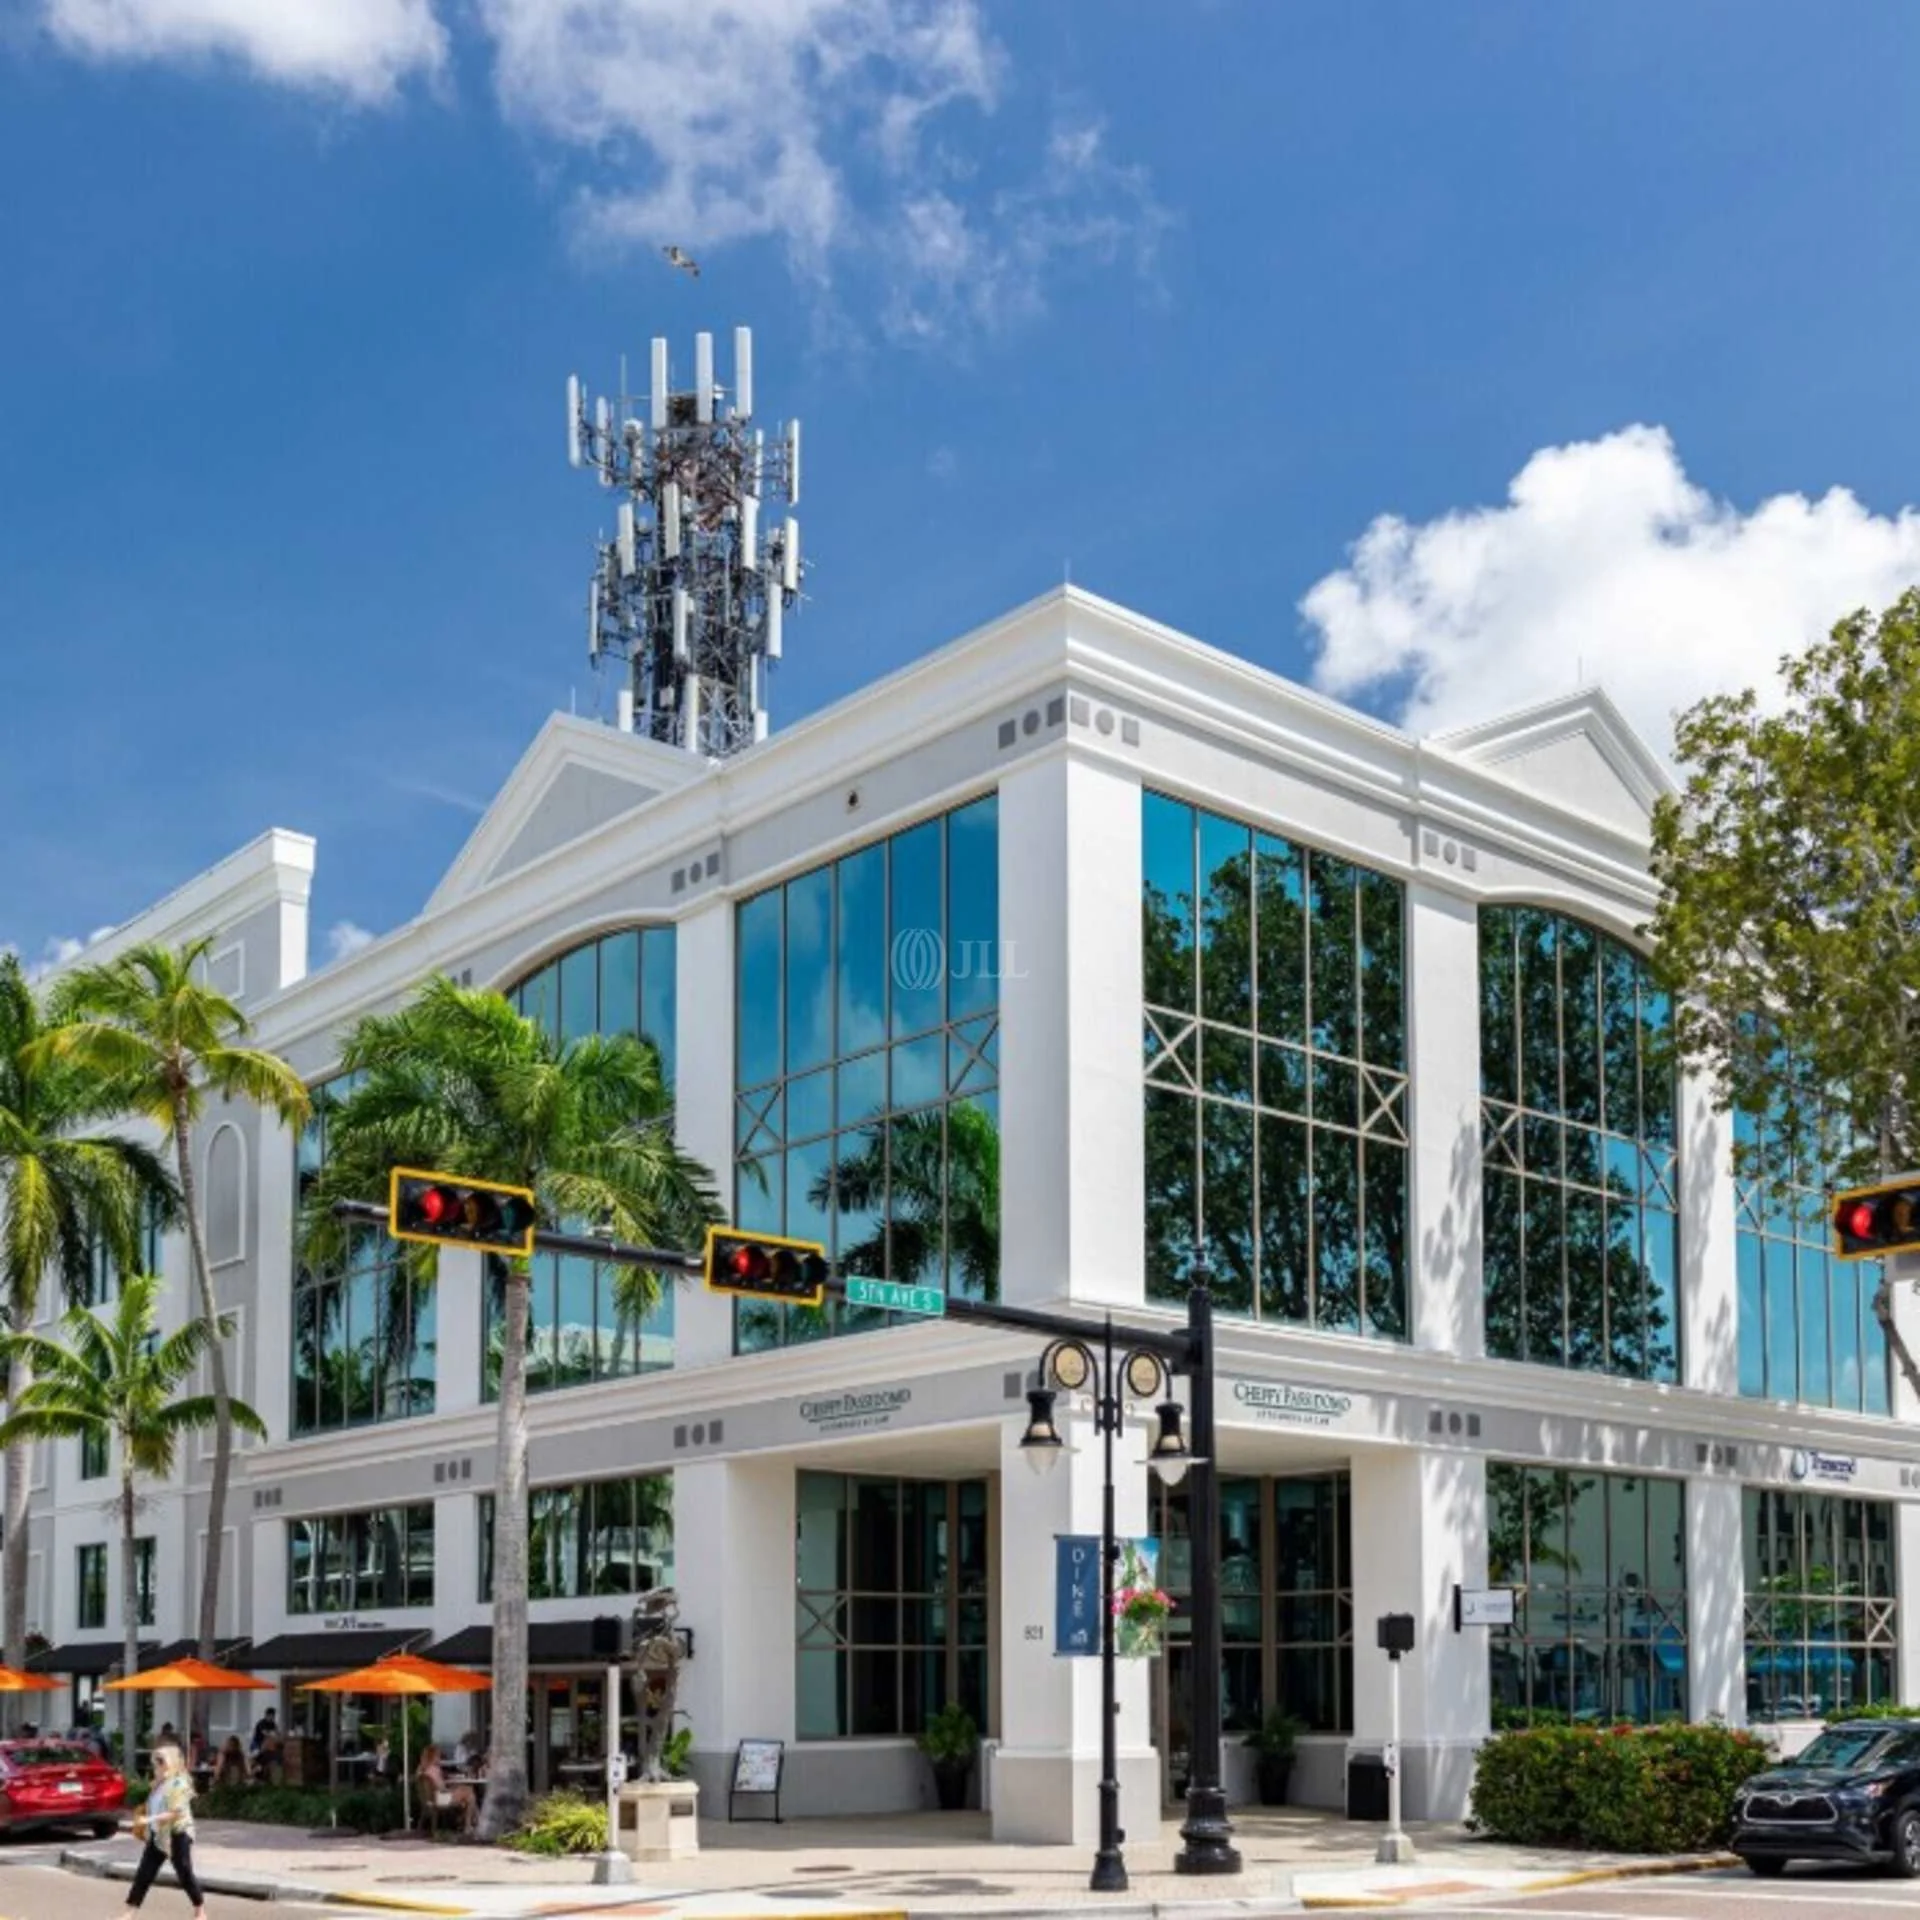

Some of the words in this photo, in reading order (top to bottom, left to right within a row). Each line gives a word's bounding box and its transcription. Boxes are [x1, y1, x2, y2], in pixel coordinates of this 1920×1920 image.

[860, 1282, 885, 1303] 5TH
[891, 1288, 917, 1308] AVE
[923, 1292, 933, 1311] S
